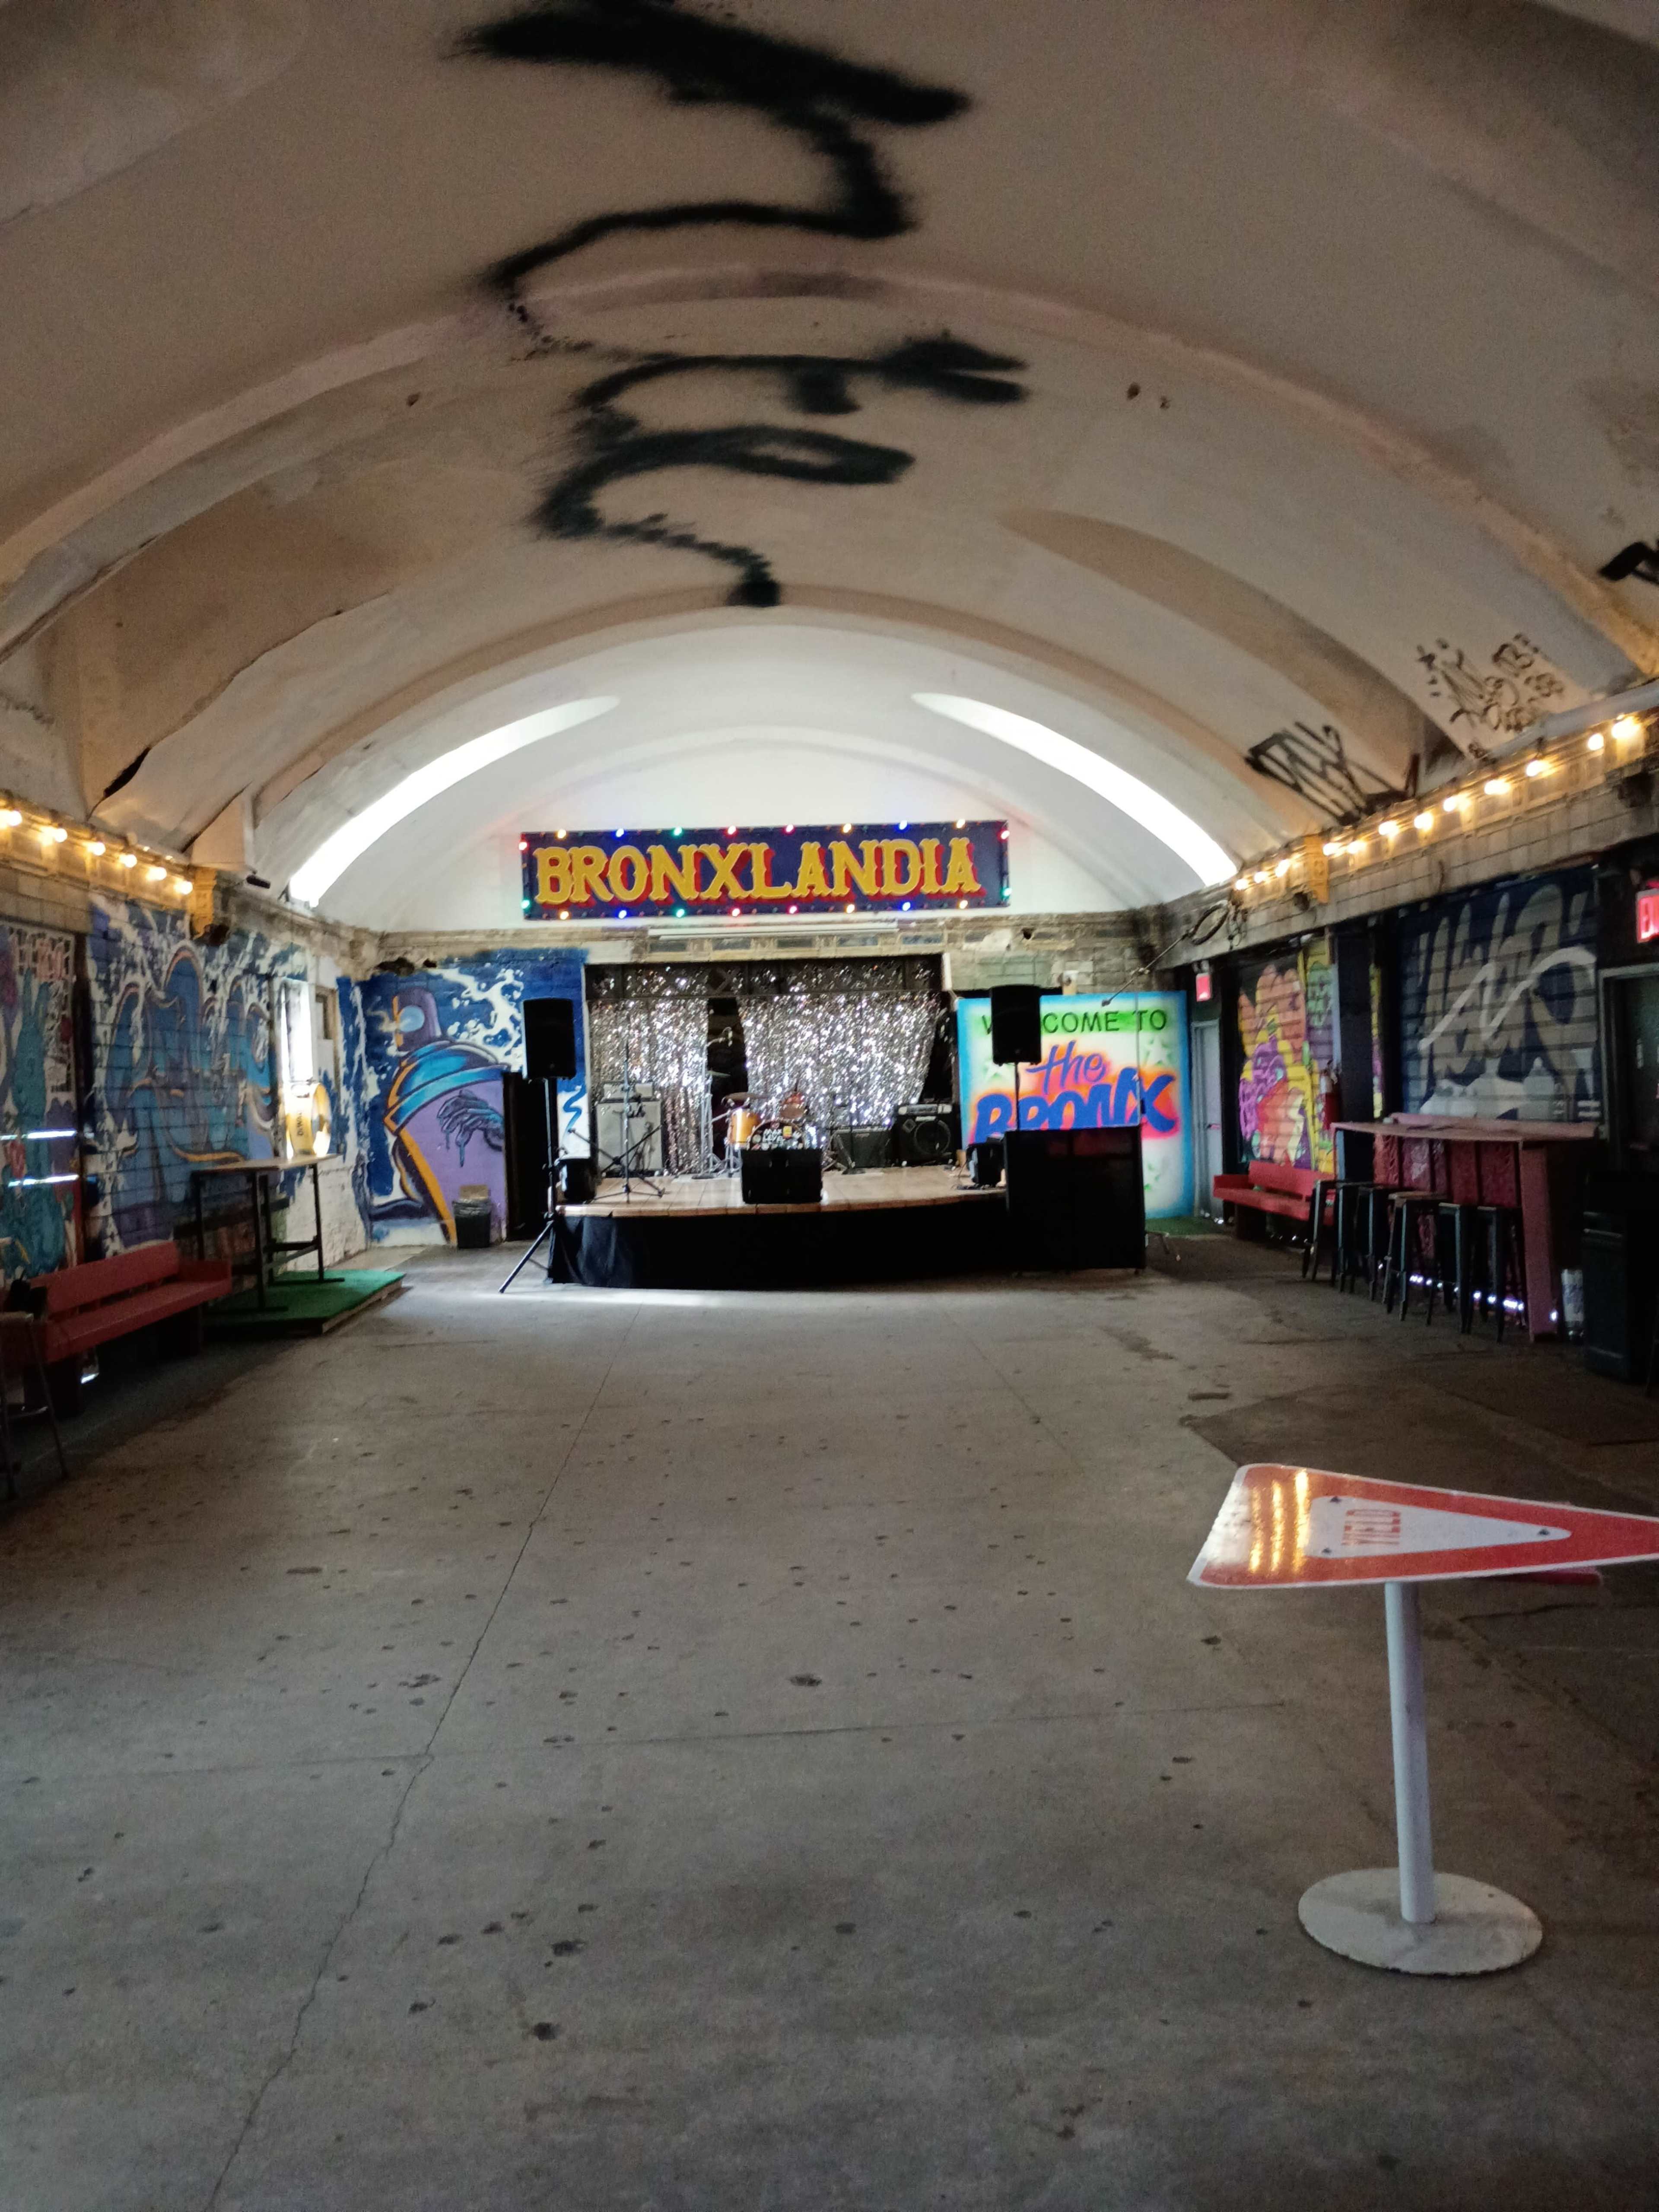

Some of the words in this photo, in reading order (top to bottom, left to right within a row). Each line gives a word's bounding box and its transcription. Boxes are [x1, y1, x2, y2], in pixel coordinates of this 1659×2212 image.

[533, 837, 983, 906] BRONXLANDIA
[982, 1010, 1119, 1036] COME
[1132, 1009, 1166, 1032] TO
[1026, 1040, 1108, 1095] the
[1341, 1509, 1401, 1546] YIELD
